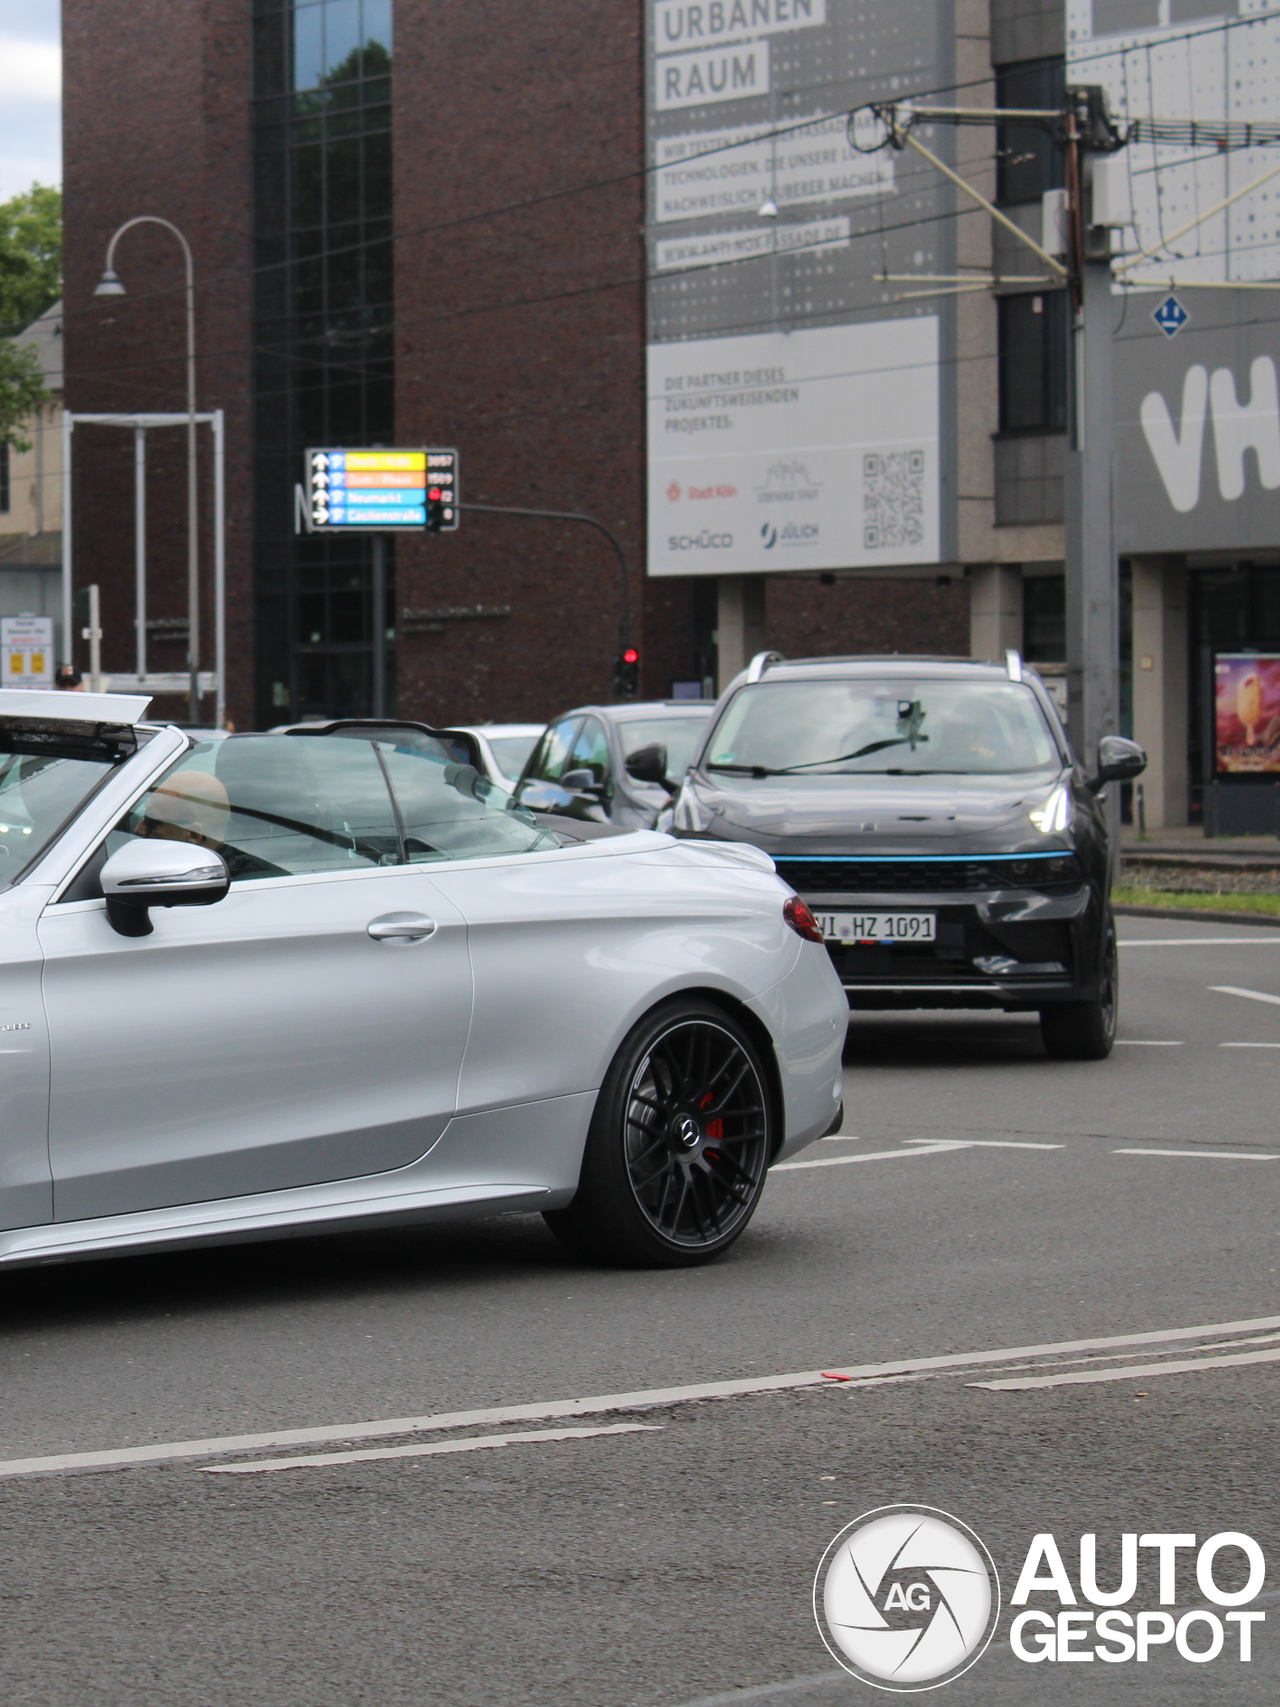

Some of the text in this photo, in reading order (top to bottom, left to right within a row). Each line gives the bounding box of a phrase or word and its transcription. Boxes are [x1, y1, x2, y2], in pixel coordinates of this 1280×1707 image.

[665, 54, 756, 99] RAUM
[761, 179, 825, 201] SUBERER
[665, 366, 785, 391] DIE PARTNER DIESES
[348, 491, 402, 504] Neumarkt
[853, 916, 878, 937] HZ
[885, 917, 932, 938] 1091
